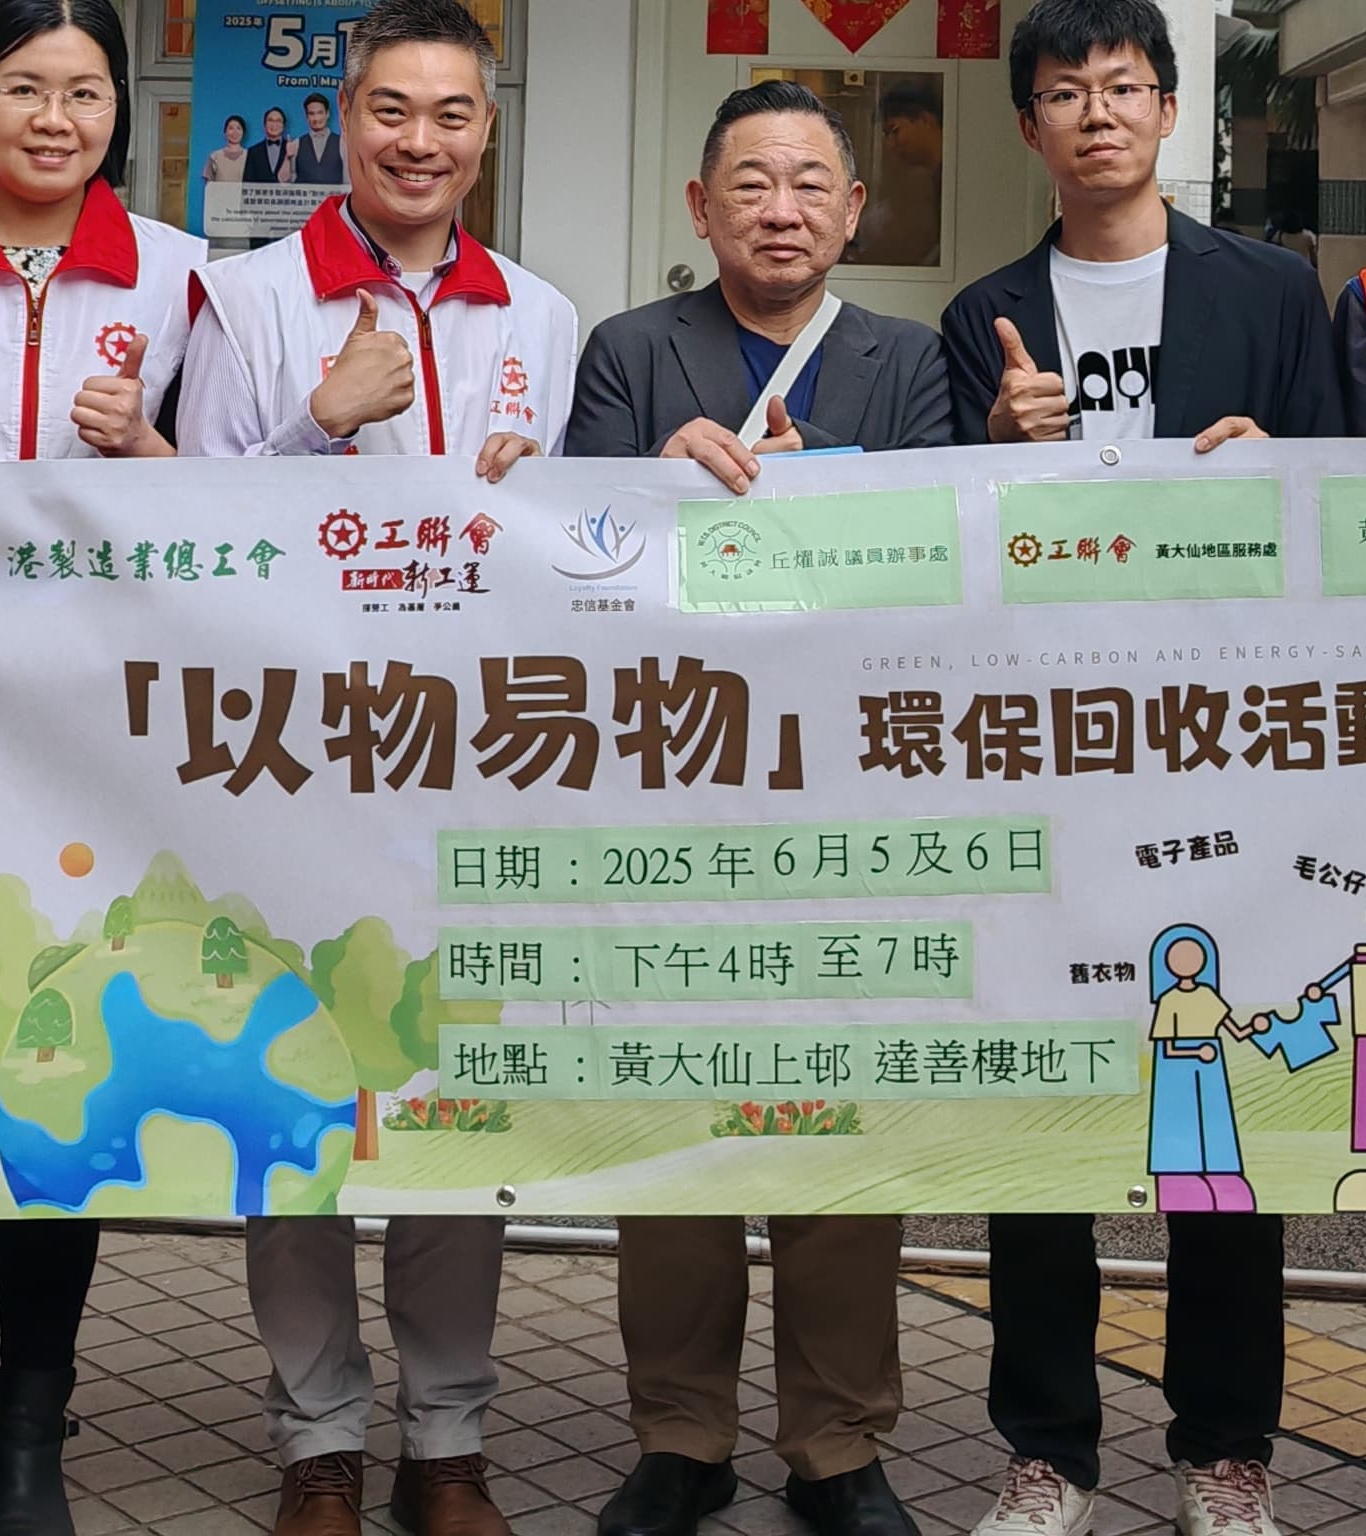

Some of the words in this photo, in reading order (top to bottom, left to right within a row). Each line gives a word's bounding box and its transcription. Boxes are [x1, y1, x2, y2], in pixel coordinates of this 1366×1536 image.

[278, 76, 308, 86] From
[374, 511, 503, 558] 工聯會
[1047, 533, 1138, 565] 工聯會
[1155, 541, 1278, 560] 黃大仙地區服務處
[571, 598, 635, 613] 忠信基金會
[862, 656, 954, 672] GREEN,
[971, 650, 1138, 669] LOW-CARBON
[1156, 648, 1202, 662] AND
[1135, 830, 1240, 870] 電子產品
[1069, 962, 1136, 984] 舊衣物
